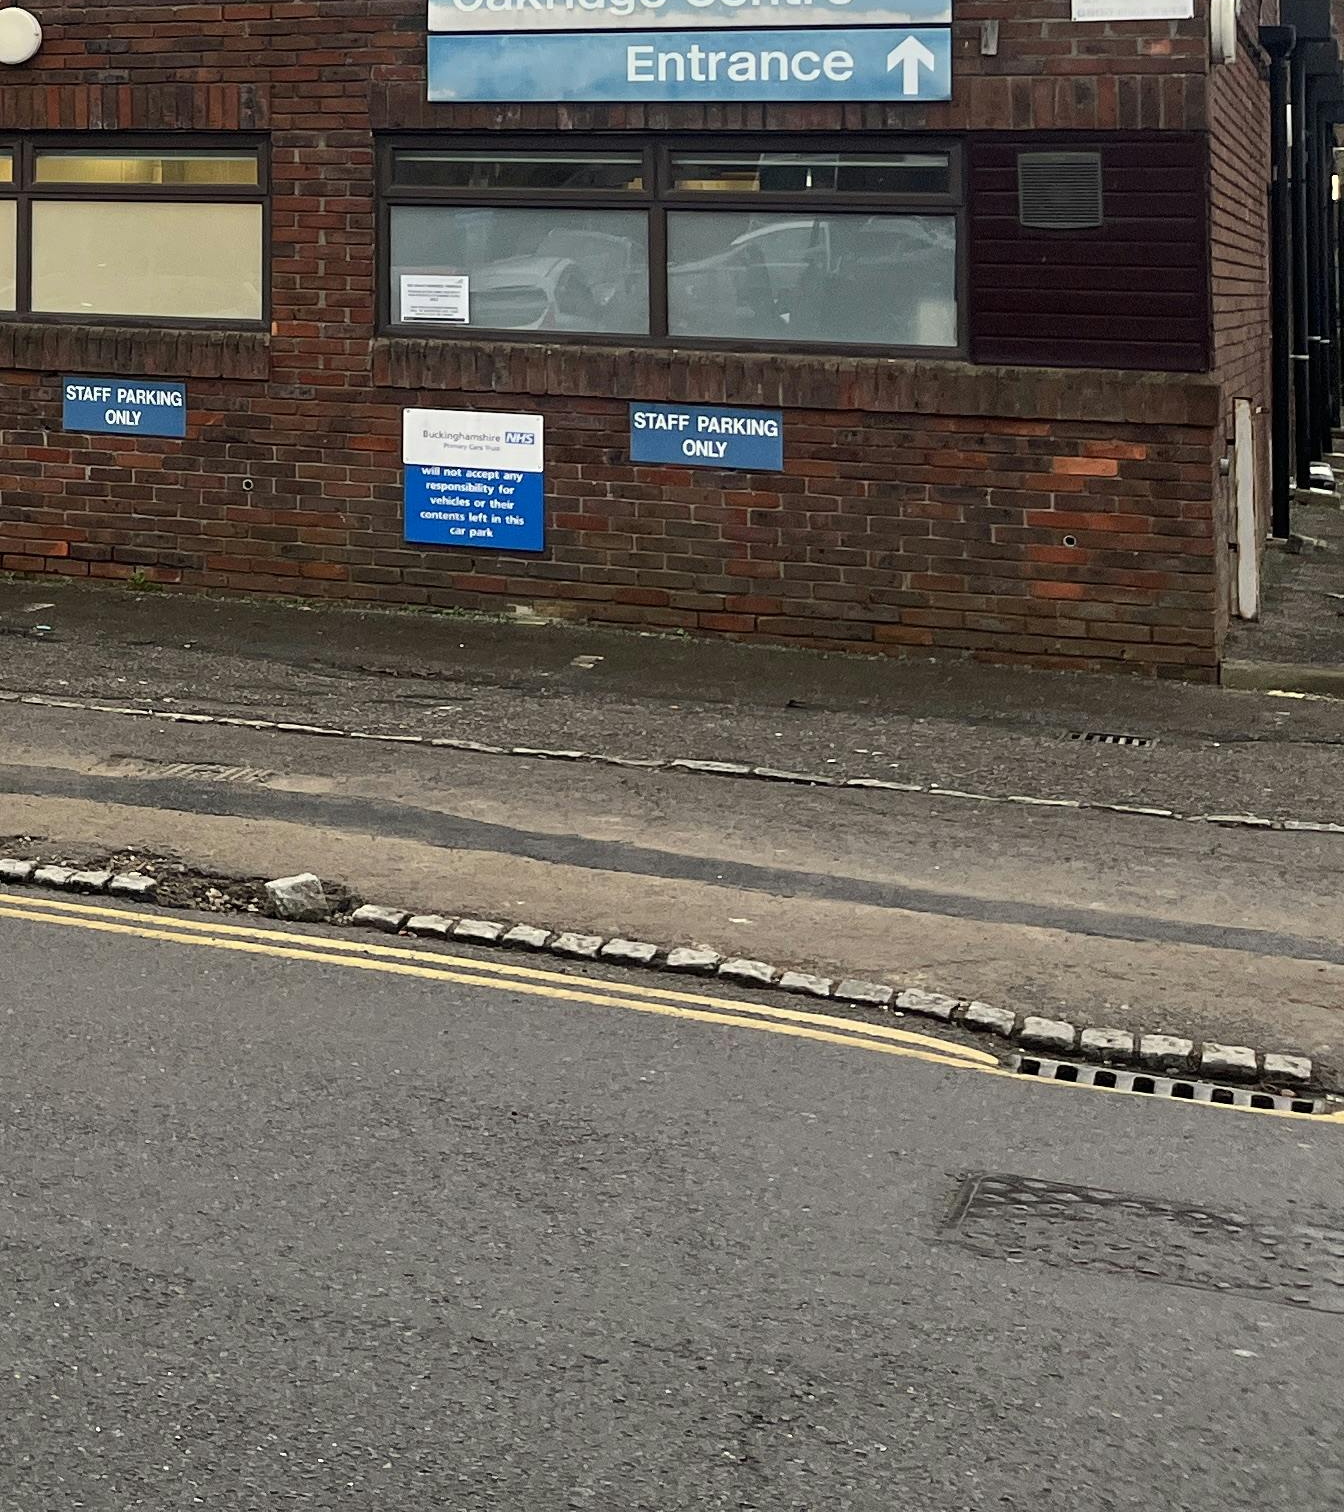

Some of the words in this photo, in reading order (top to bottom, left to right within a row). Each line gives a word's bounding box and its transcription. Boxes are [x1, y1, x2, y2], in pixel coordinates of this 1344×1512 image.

[627, 45, 854, 83] Entrance
[66, 385, 111, 402] STAFF
[117, 388, 182, 407] PARKING
[105, 409, 141, 425] ONLY
[634, 412, 690, 431] STAFF
[698, 416, 778, 437] PARKING
[423, 430, 500, 442] Buckinghamshire
[505, 432, 534, 445] NHS
[682, 439, 727, 458] ONLY
[421, 467, 440, 476] will
[444, 468, 462, 477] not
[466, 470, 500, 481] accept
[503, 473, 523, 483] any
[426, 481, 494, 495] responsibility
[498, 484, 515, 495] for
[430, 496, 470, 507] vehicles
[474, 499, 486, 507] or
[489, 498, 514, 509] their
[420, 511, 465, 521] contents
[468, 512, 488, 523] left
[491, 514, 501, 524] in
[505, 515, 524, 526] this
[449, 526, 465, 535] car
[469, 528, 493, 538] park
